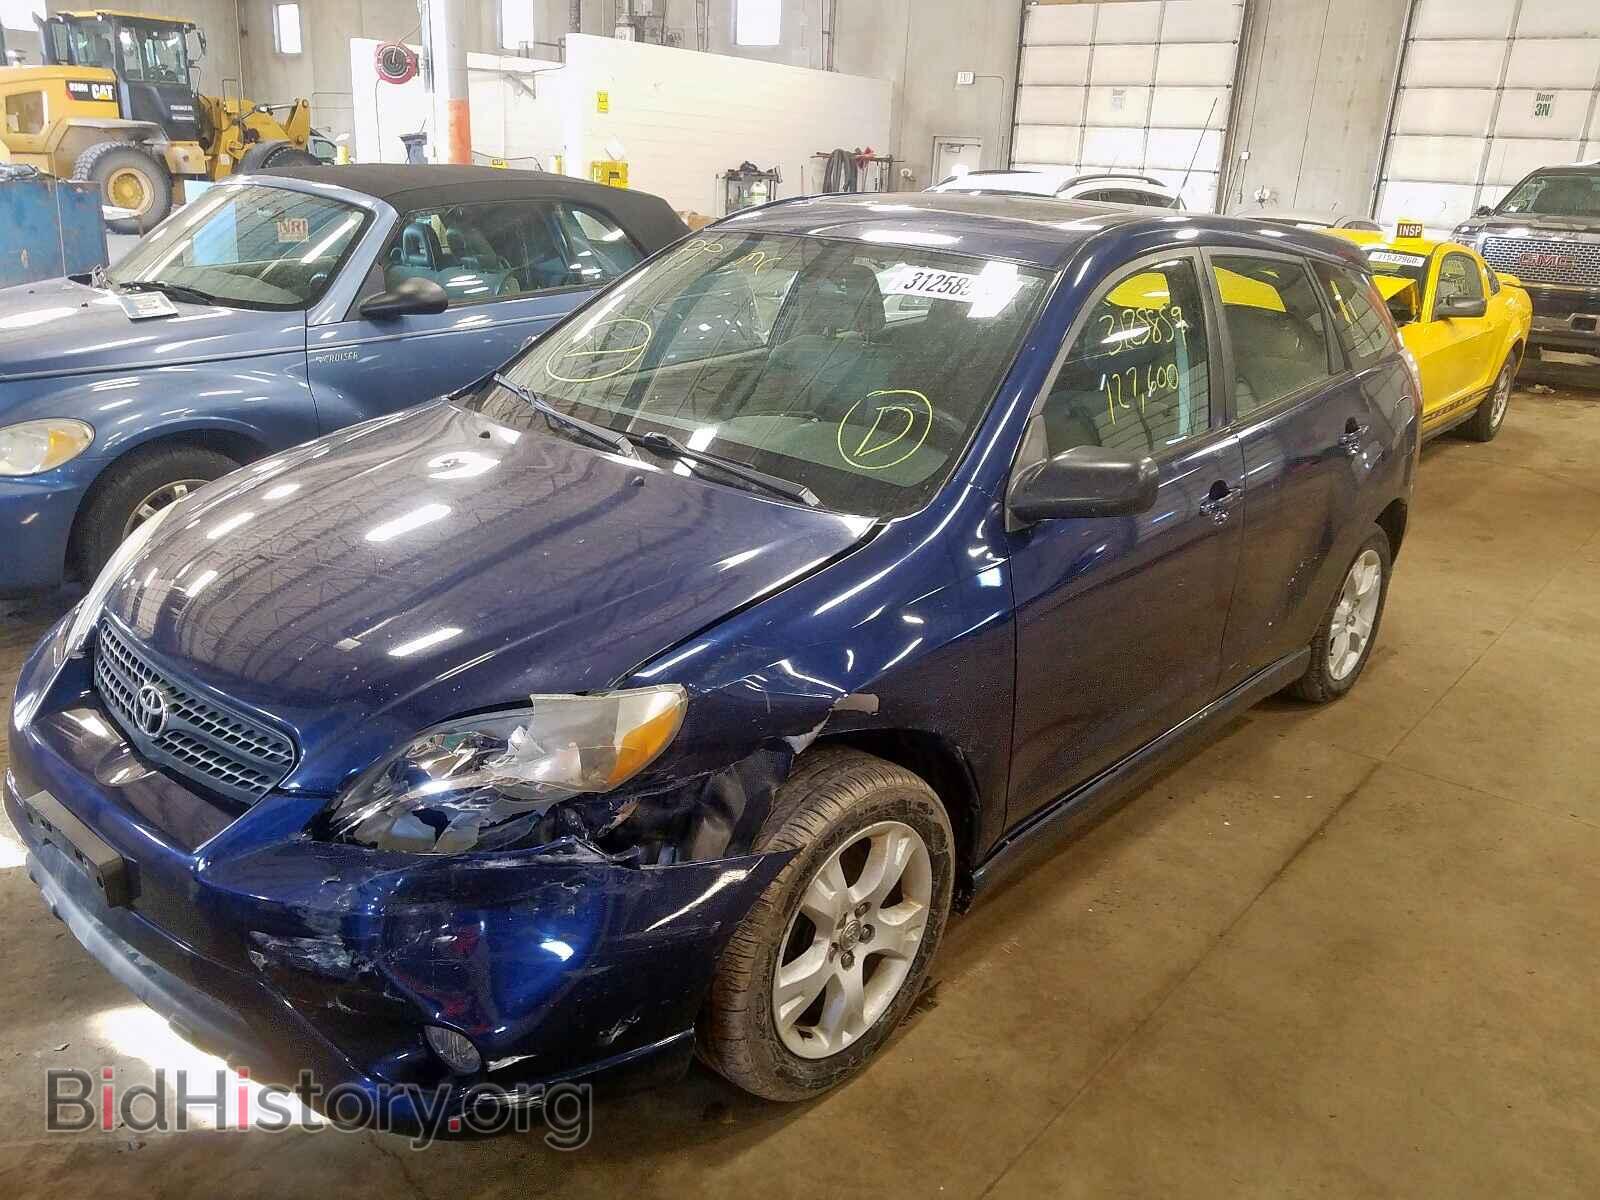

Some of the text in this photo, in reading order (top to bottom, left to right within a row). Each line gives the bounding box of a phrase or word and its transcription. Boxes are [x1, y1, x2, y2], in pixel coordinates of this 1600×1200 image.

[91, 83, 114, 100] CAT
[1534, 103, 1551, 116] 3N
[1399, 225, 1422, 237] INSP
[1519, 253, 1575, 269] GMC
